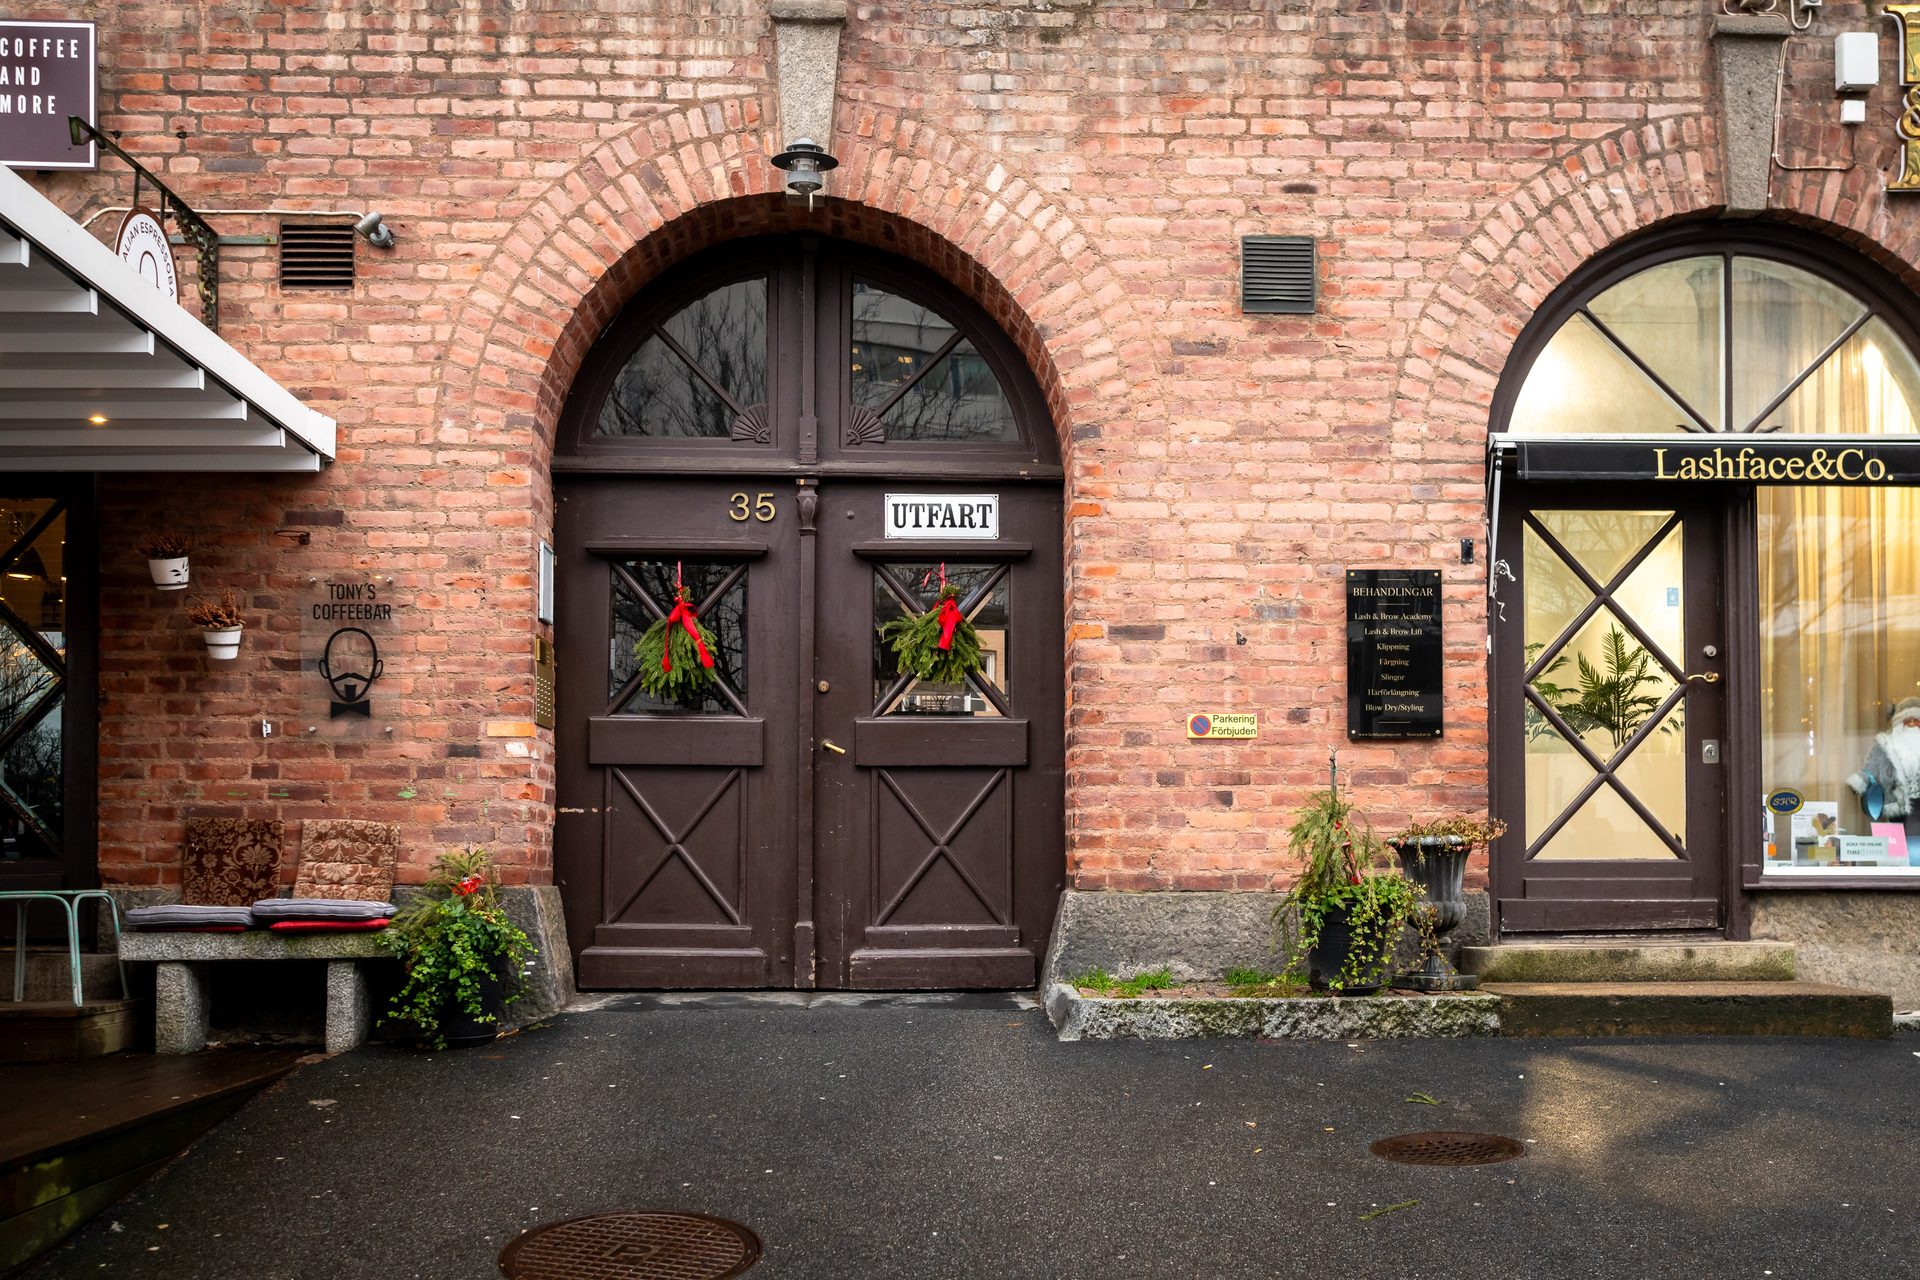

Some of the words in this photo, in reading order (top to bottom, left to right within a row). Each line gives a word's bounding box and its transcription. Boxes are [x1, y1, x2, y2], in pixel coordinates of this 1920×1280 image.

[0, 37, 79, 58] COFFEE
[0, 65, 41, 86] AND
[0, 94, 56, 115] MORE
[1653, 447, 1895, 481] Lashface&Co.
[729, 492, 777, 522] 35
[892, 502, 993, 529] UTFART
[1353, 587, 1433, 597] BEHANDLINGAR
[313, 604, 391, 620] COFFEEBAR
[1354, 612, 1371, 621] Lash
[1400, 613, 1433, 622] Academy
[1376, 643, 1410, 652] Klippning
[1381, 673, 1406, 682] Slingor
[1384, 703, 1425, 713] Dry/Styling
[1212, 714, 1256, 726] Parkering
[1211, 726, 1257, 738] Förbjuden
